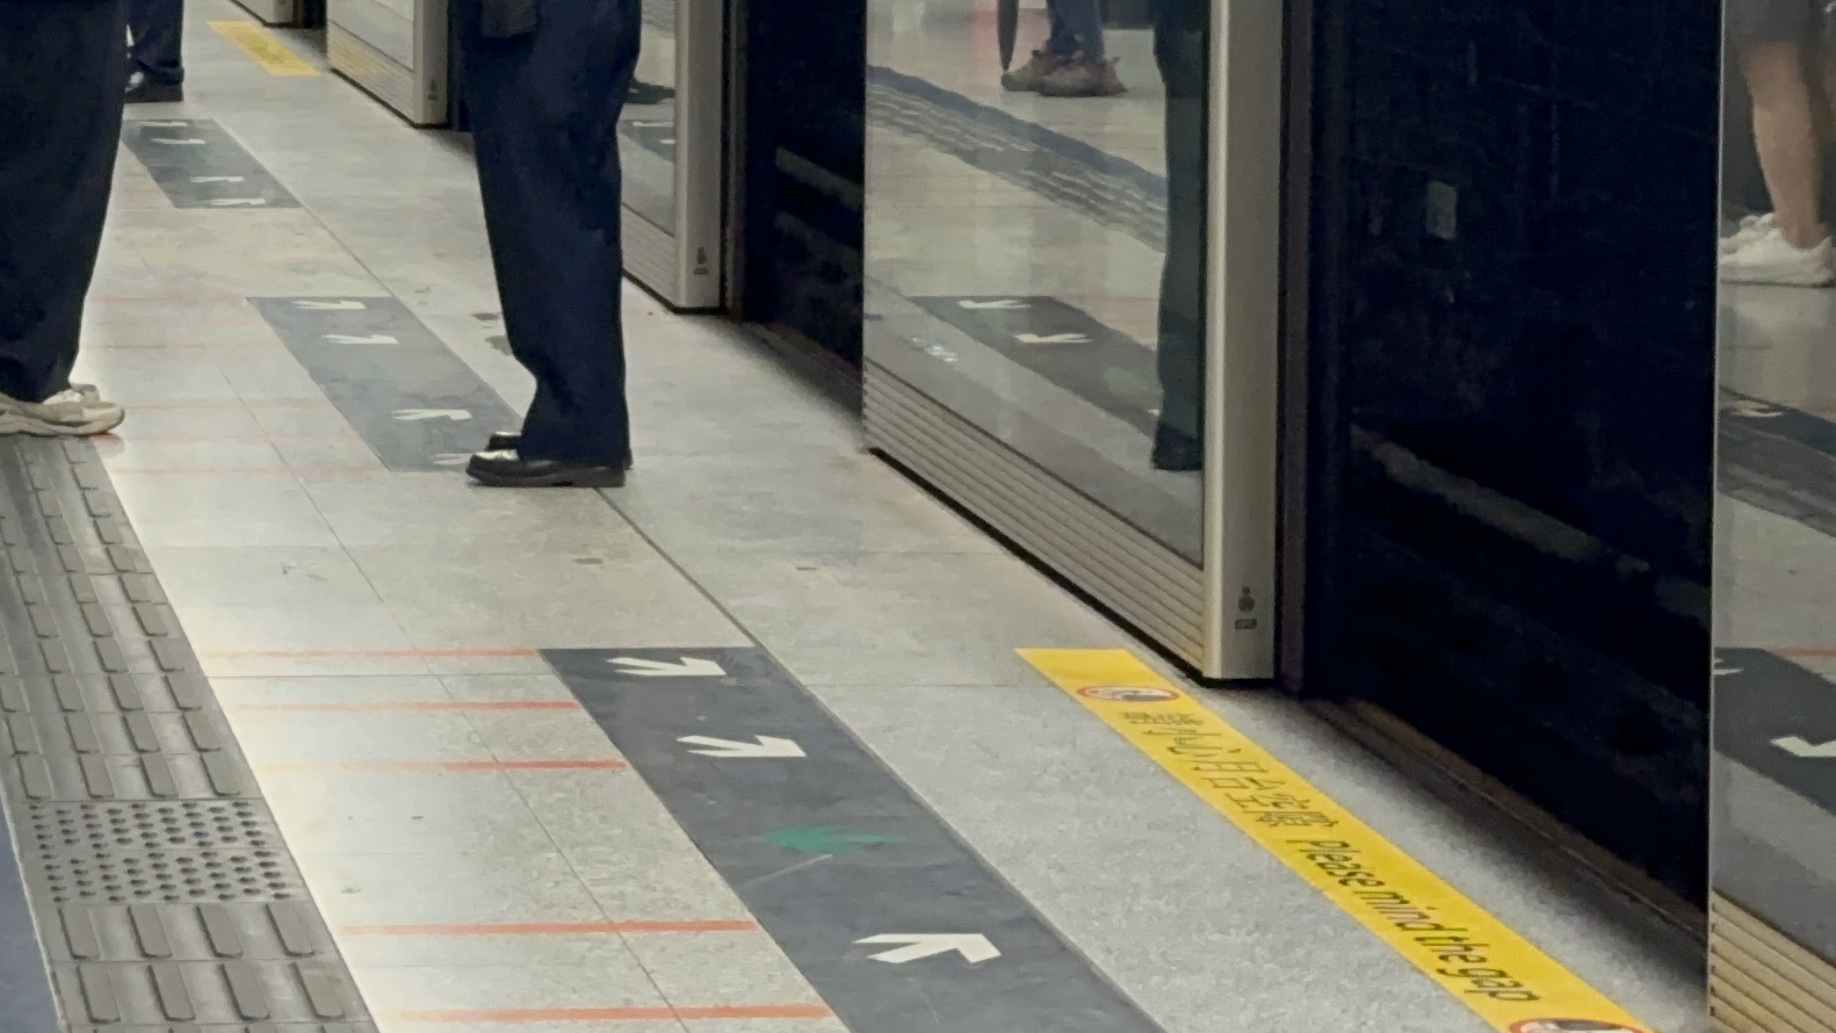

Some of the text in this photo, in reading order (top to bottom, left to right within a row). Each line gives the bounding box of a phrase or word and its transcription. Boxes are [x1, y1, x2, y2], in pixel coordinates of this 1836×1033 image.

[1285, 839, 1542, 1002] Please mind the gap
